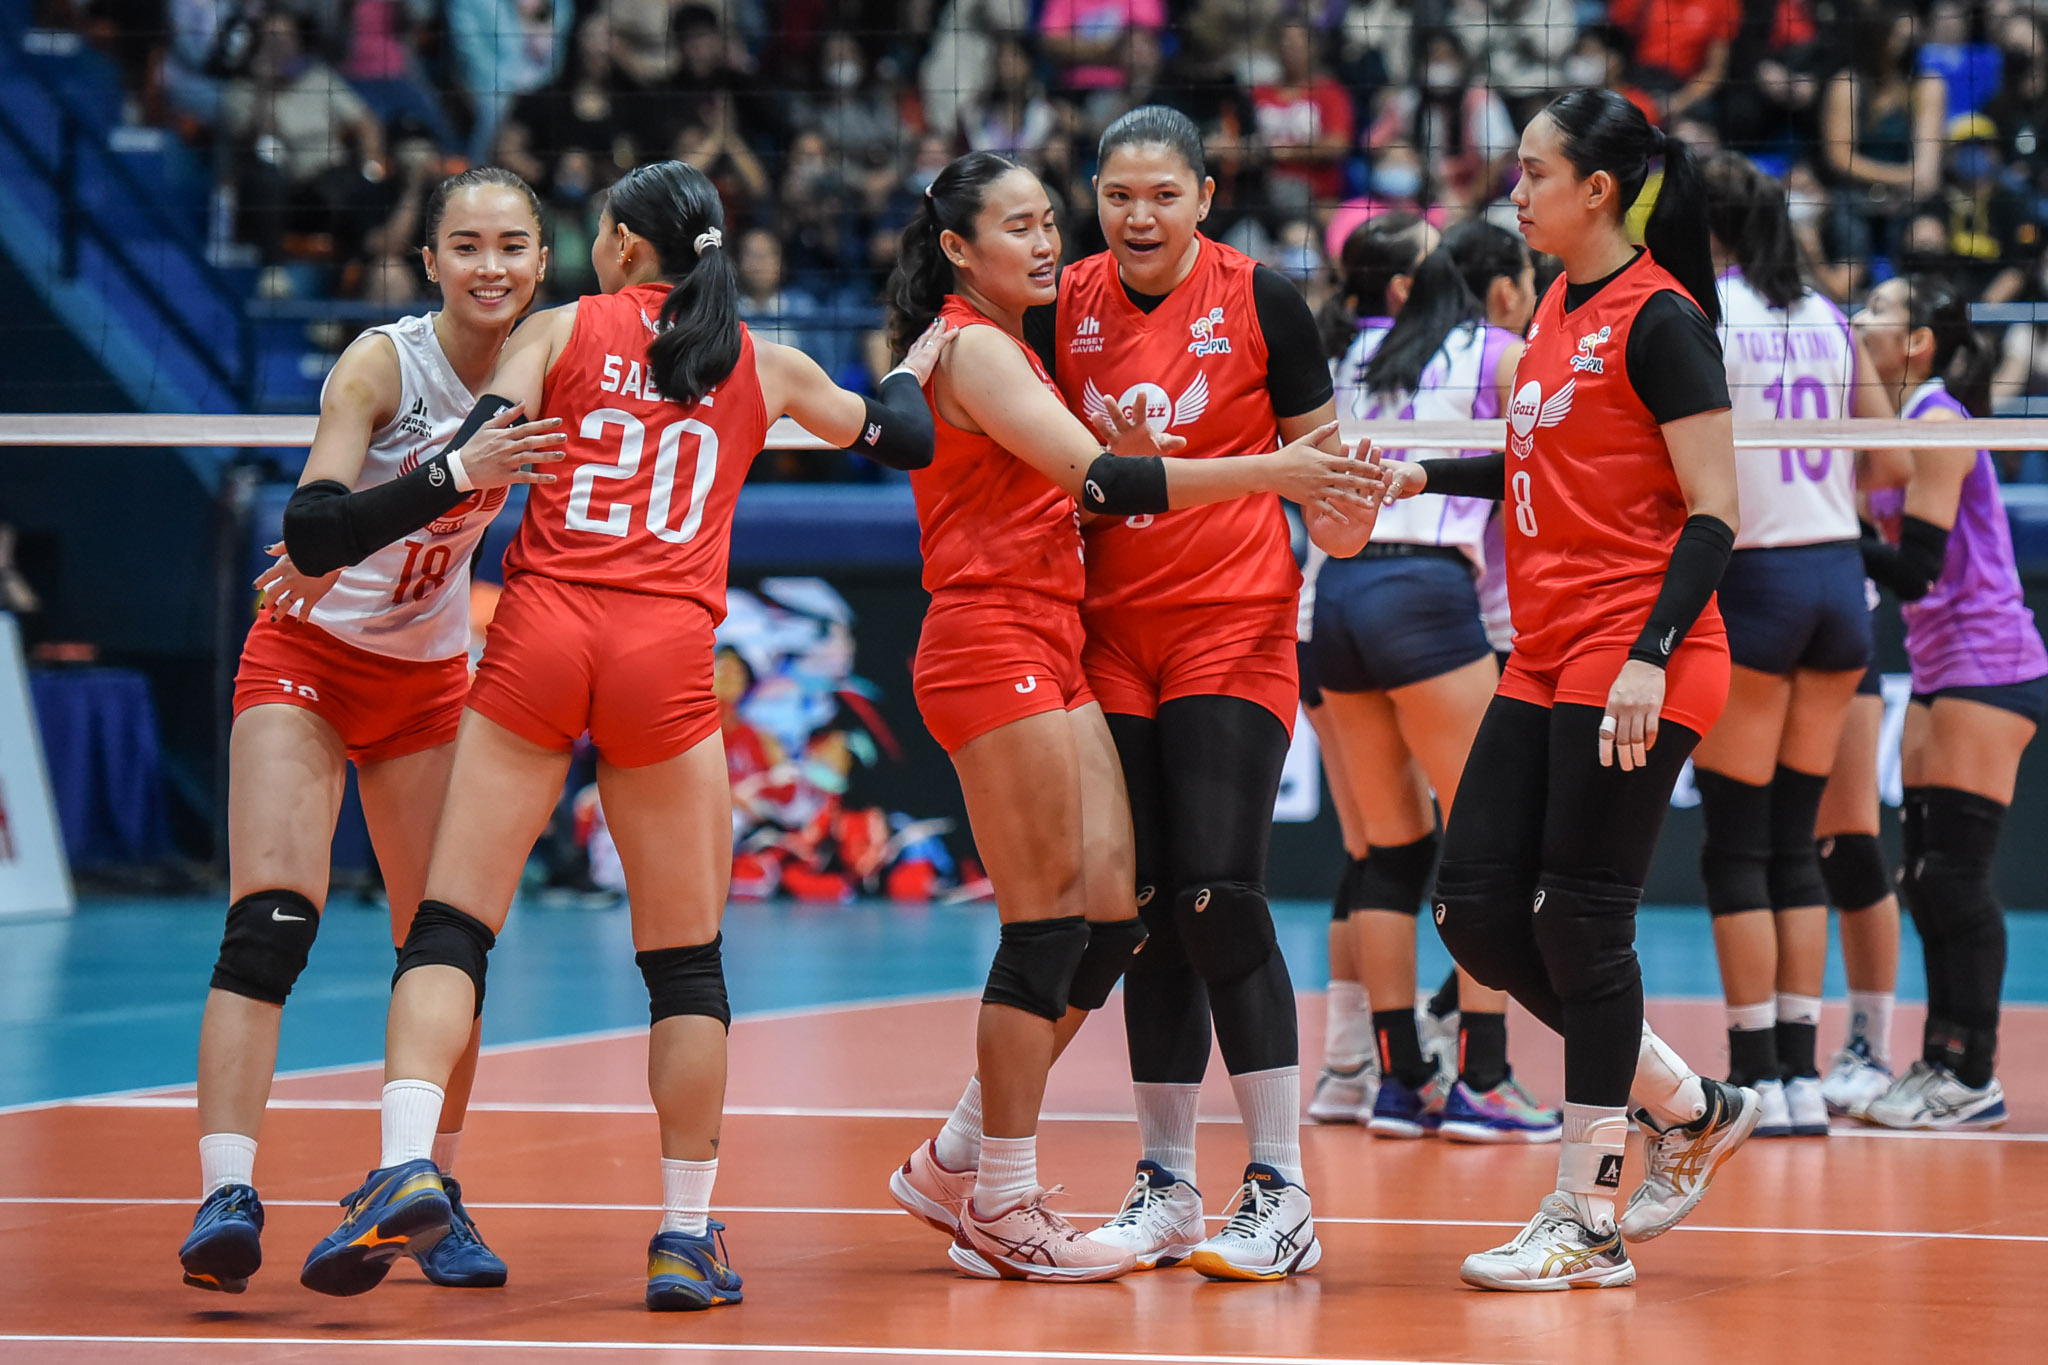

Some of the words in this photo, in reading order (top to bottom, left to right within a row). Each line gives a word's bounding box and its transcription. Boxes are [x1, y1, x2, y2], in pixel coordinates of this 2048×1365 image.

[1070, 337, 1105, 347] JERSEY
[1070, 345, 1103, 354] HAVEN
[1211, 339, 1230, 352] PVL
[1586, 358, 1602, 373] PVL
[1122, 405, 1166, 420] Gzz
[1513, 400, 1536, 417] Gazz
[564, 408, 719, 544] 20
[1512, 470, 1539, 537] 8
[391, 540, 452, 605] 18
